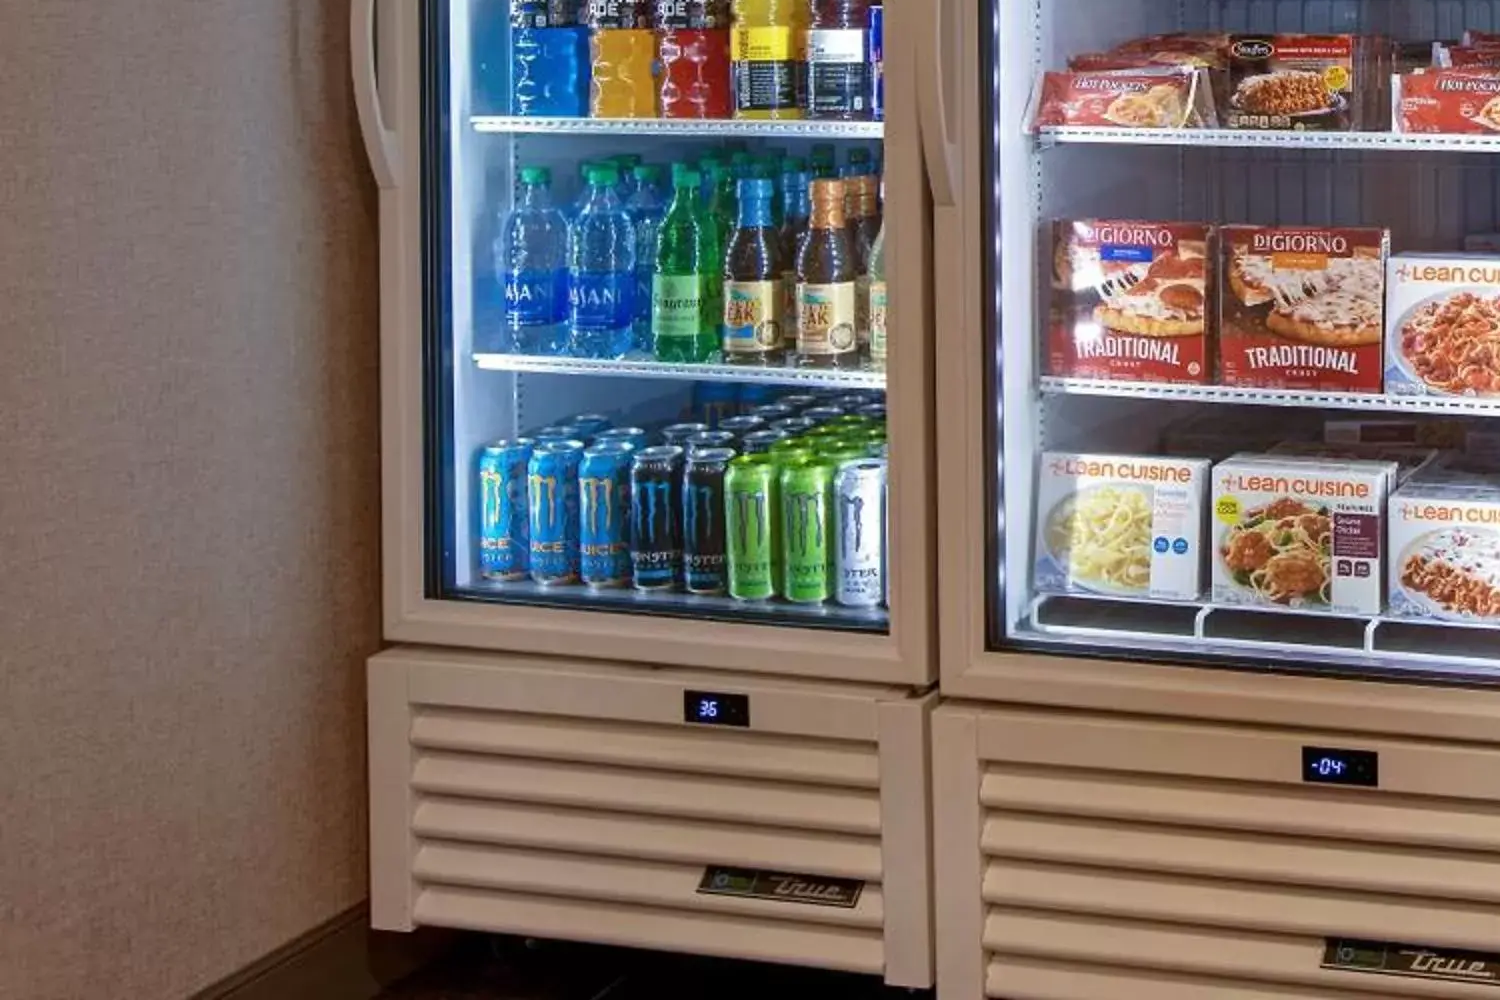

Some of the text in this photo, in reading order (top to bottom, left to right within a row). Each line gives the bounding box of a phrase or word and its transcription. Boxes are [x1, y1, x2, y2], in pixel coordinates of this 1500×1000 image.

[1413, 264, 1465, 283] Lean
[569, 286, 623, 306] ASANI
[1075, 336, 1181, 367] TRADITIONAL
[1245, 345, 1360, 376] TRADITIONAL
[1064, 459, 1193, 483] Lean cuisine
[1237, 474, 1370, 499] Lean cuisine
[1413, 505, 1463, 521] Lean
[699, 700, 718, 717] 36
